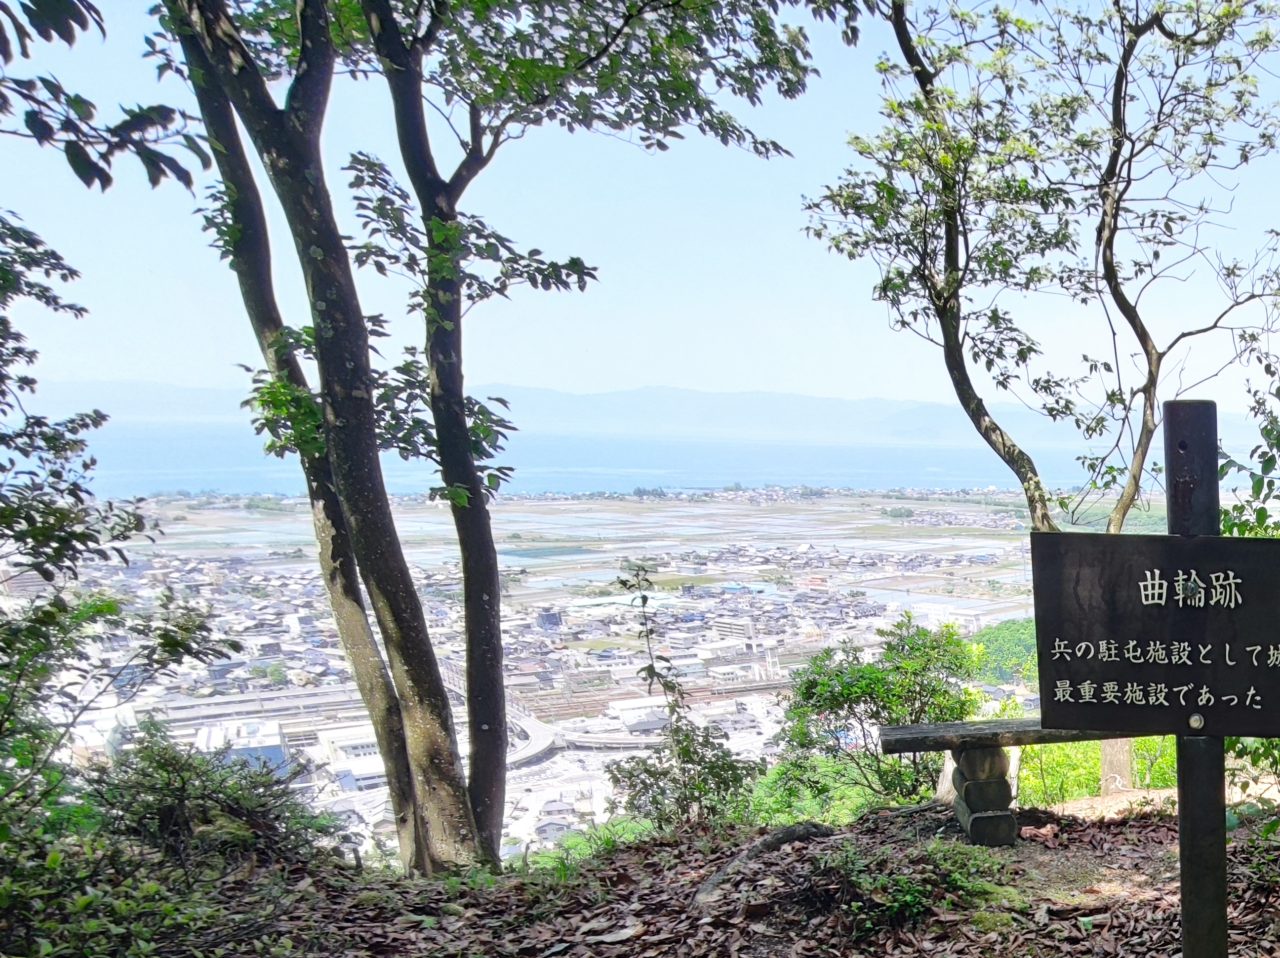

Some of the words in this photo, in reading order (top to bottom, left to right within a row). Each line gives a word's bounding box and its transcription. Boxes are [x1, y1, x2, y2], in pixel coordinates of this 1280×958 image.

[1138, 569, 1242, 608] 曲輪跡
[1053, 680, 1262, 709] 最重要施設であった
